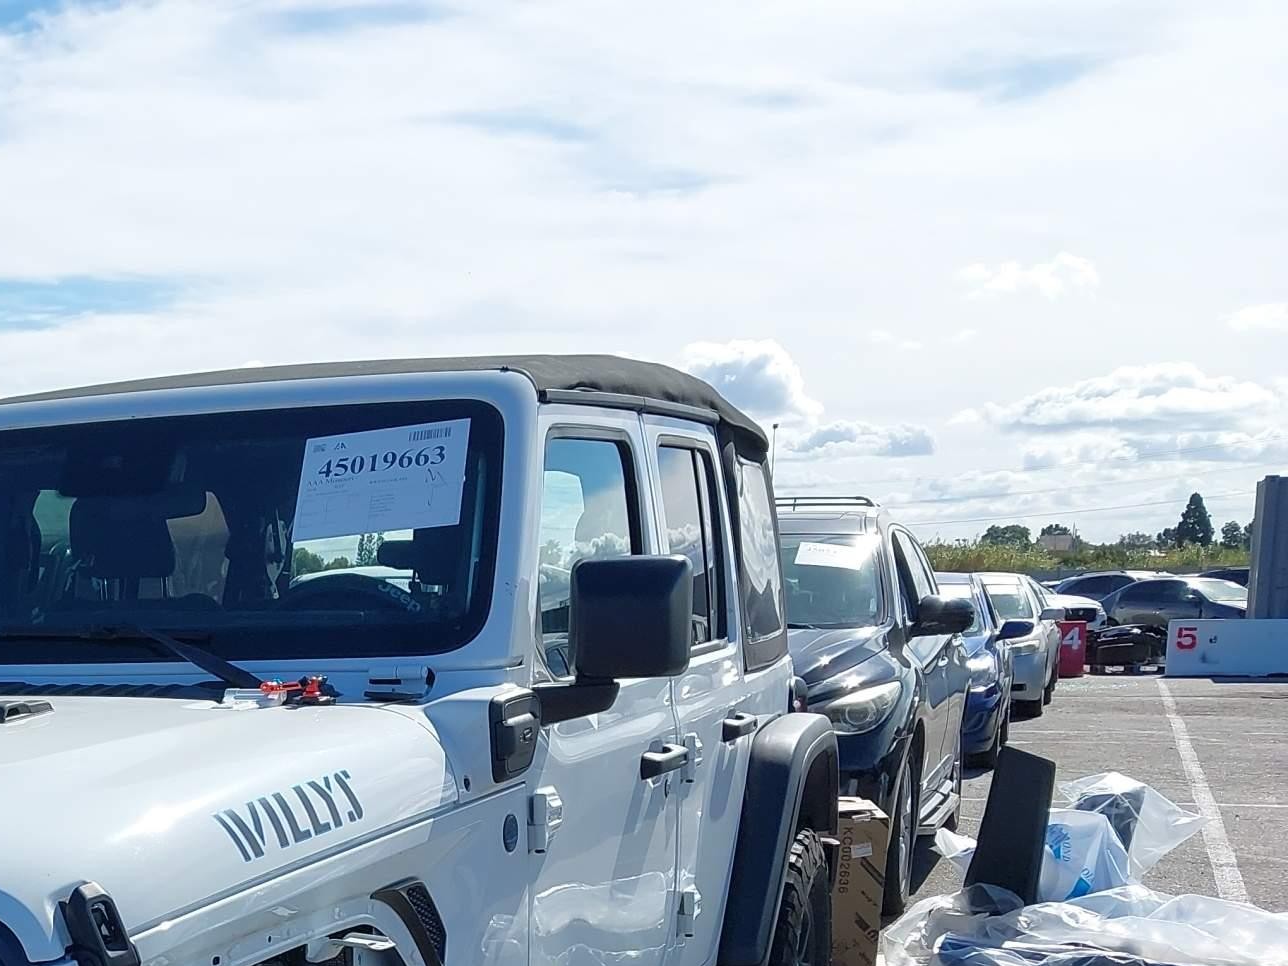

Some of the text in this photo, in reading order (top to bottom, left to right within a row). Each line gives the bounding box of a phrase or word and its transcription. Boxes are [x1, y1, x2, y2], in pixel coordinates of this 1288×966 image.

[318, 445, 446, 478] 45019663
[377, 583, 421, 613] Jeep
[1062, 626, 1081, 650] 4
[1176, 627, 1198, 650] 5
[212, 769, 364, 862] WILLYS
[838, 826, 854, 894] KC002636
